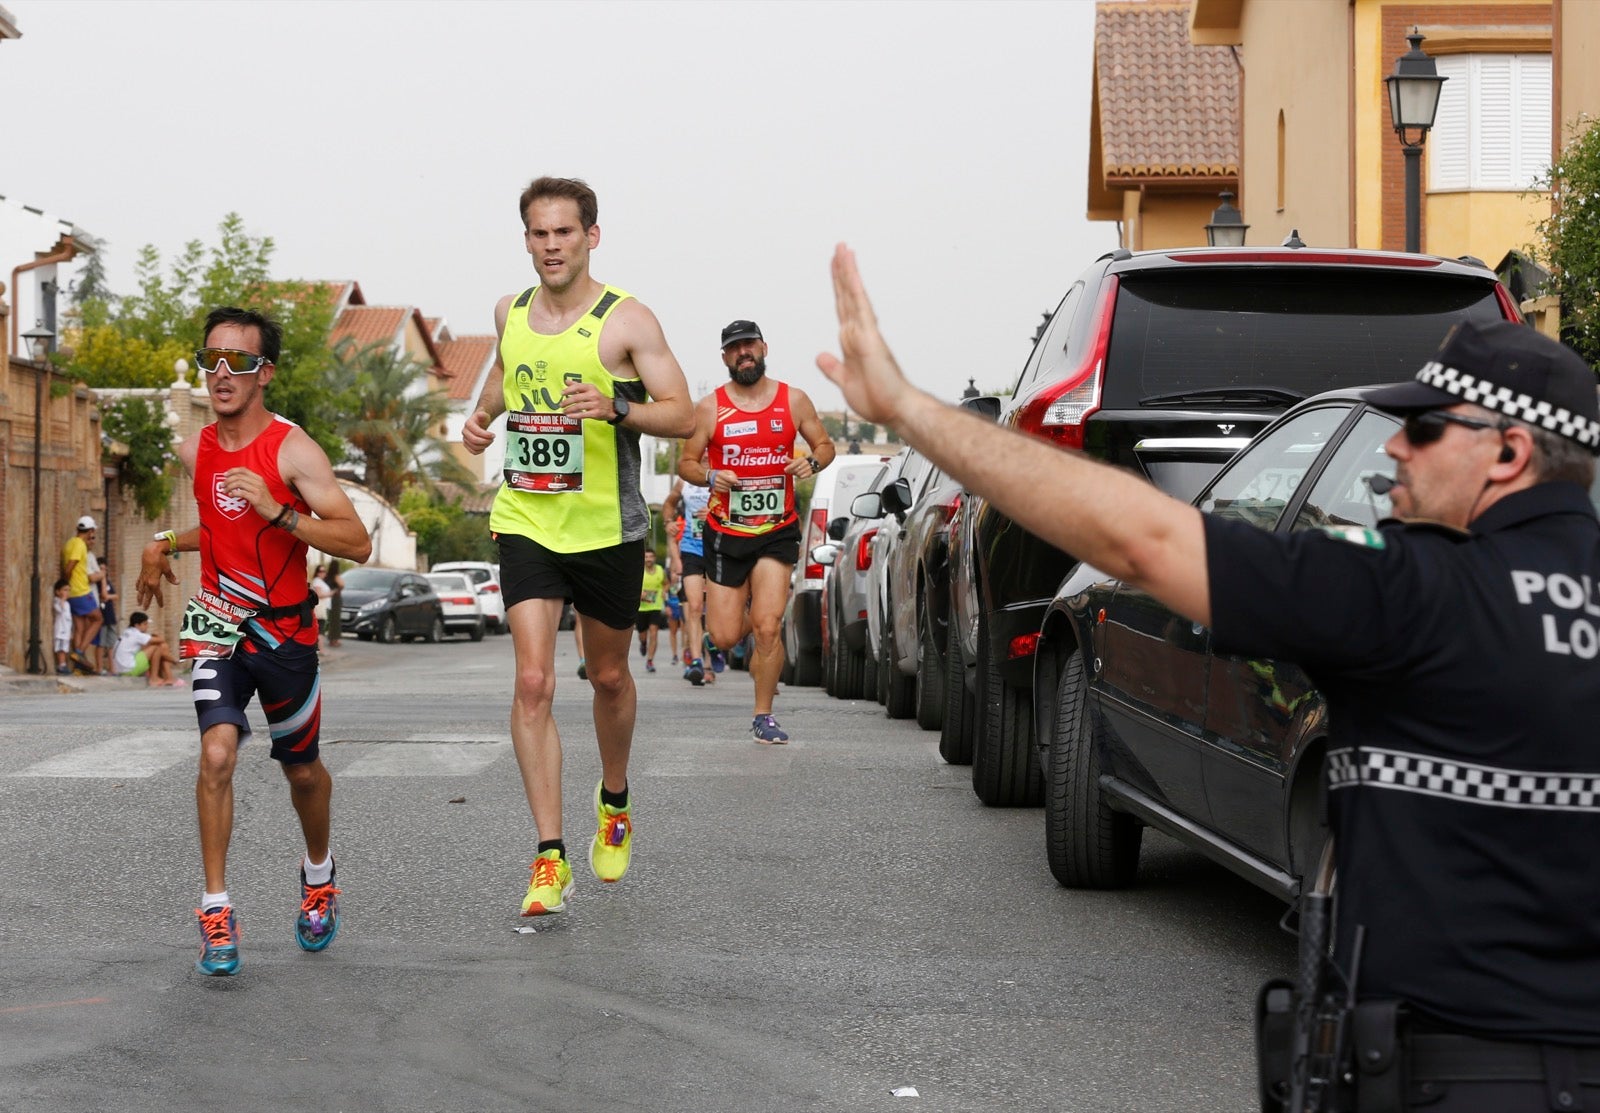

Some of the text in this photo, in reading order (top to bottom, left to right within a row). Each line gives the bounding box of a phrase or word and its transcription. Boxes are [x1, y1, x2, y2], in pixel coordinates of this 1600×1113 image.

[531, 415, 551, 425] PREMIO
[552, 416, 559, 425] DE
[518, 437, 570, 467] 389
[741, 493, 778, 511] 630
[202, 592, 222, 609] PREMIO
[222, 601, 231, 613] DE
[1510, 570, 1600, 617] POL
[1542, 613, 1600, 660] LO
